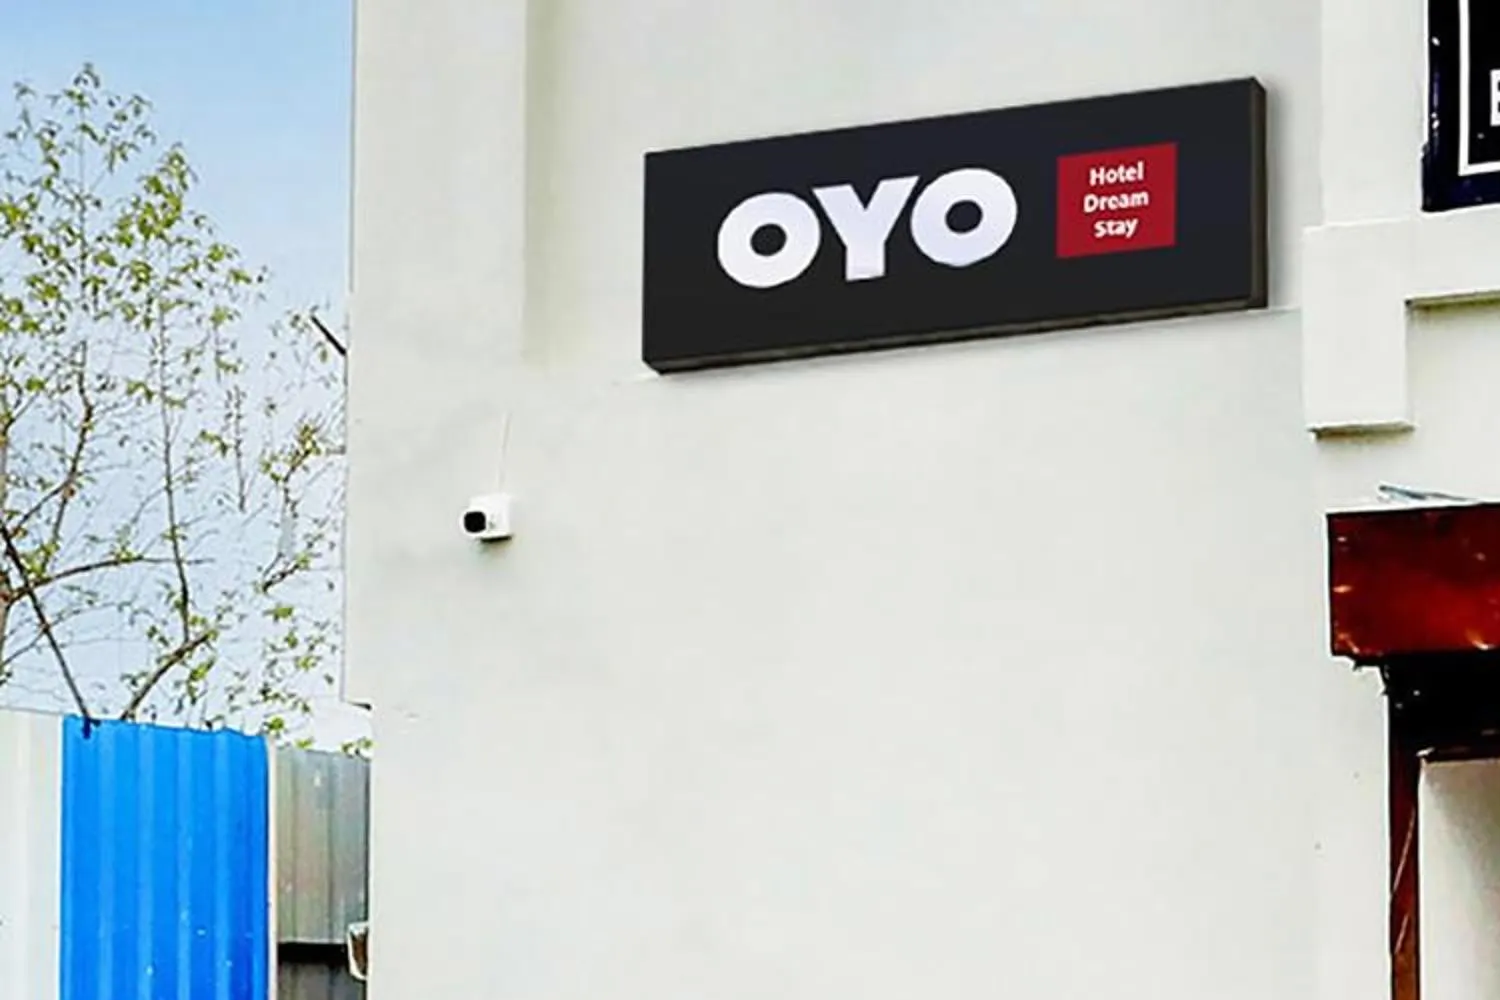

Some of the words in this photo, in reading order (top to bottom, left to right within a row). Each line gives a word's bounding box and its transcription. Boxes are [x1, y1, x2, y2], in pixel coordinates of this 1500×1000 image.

[1089, 160, 1145, 186] Hotel
[1083, 190, 1150, 213] Dream
[717, 168, 1018, 288] OYO
